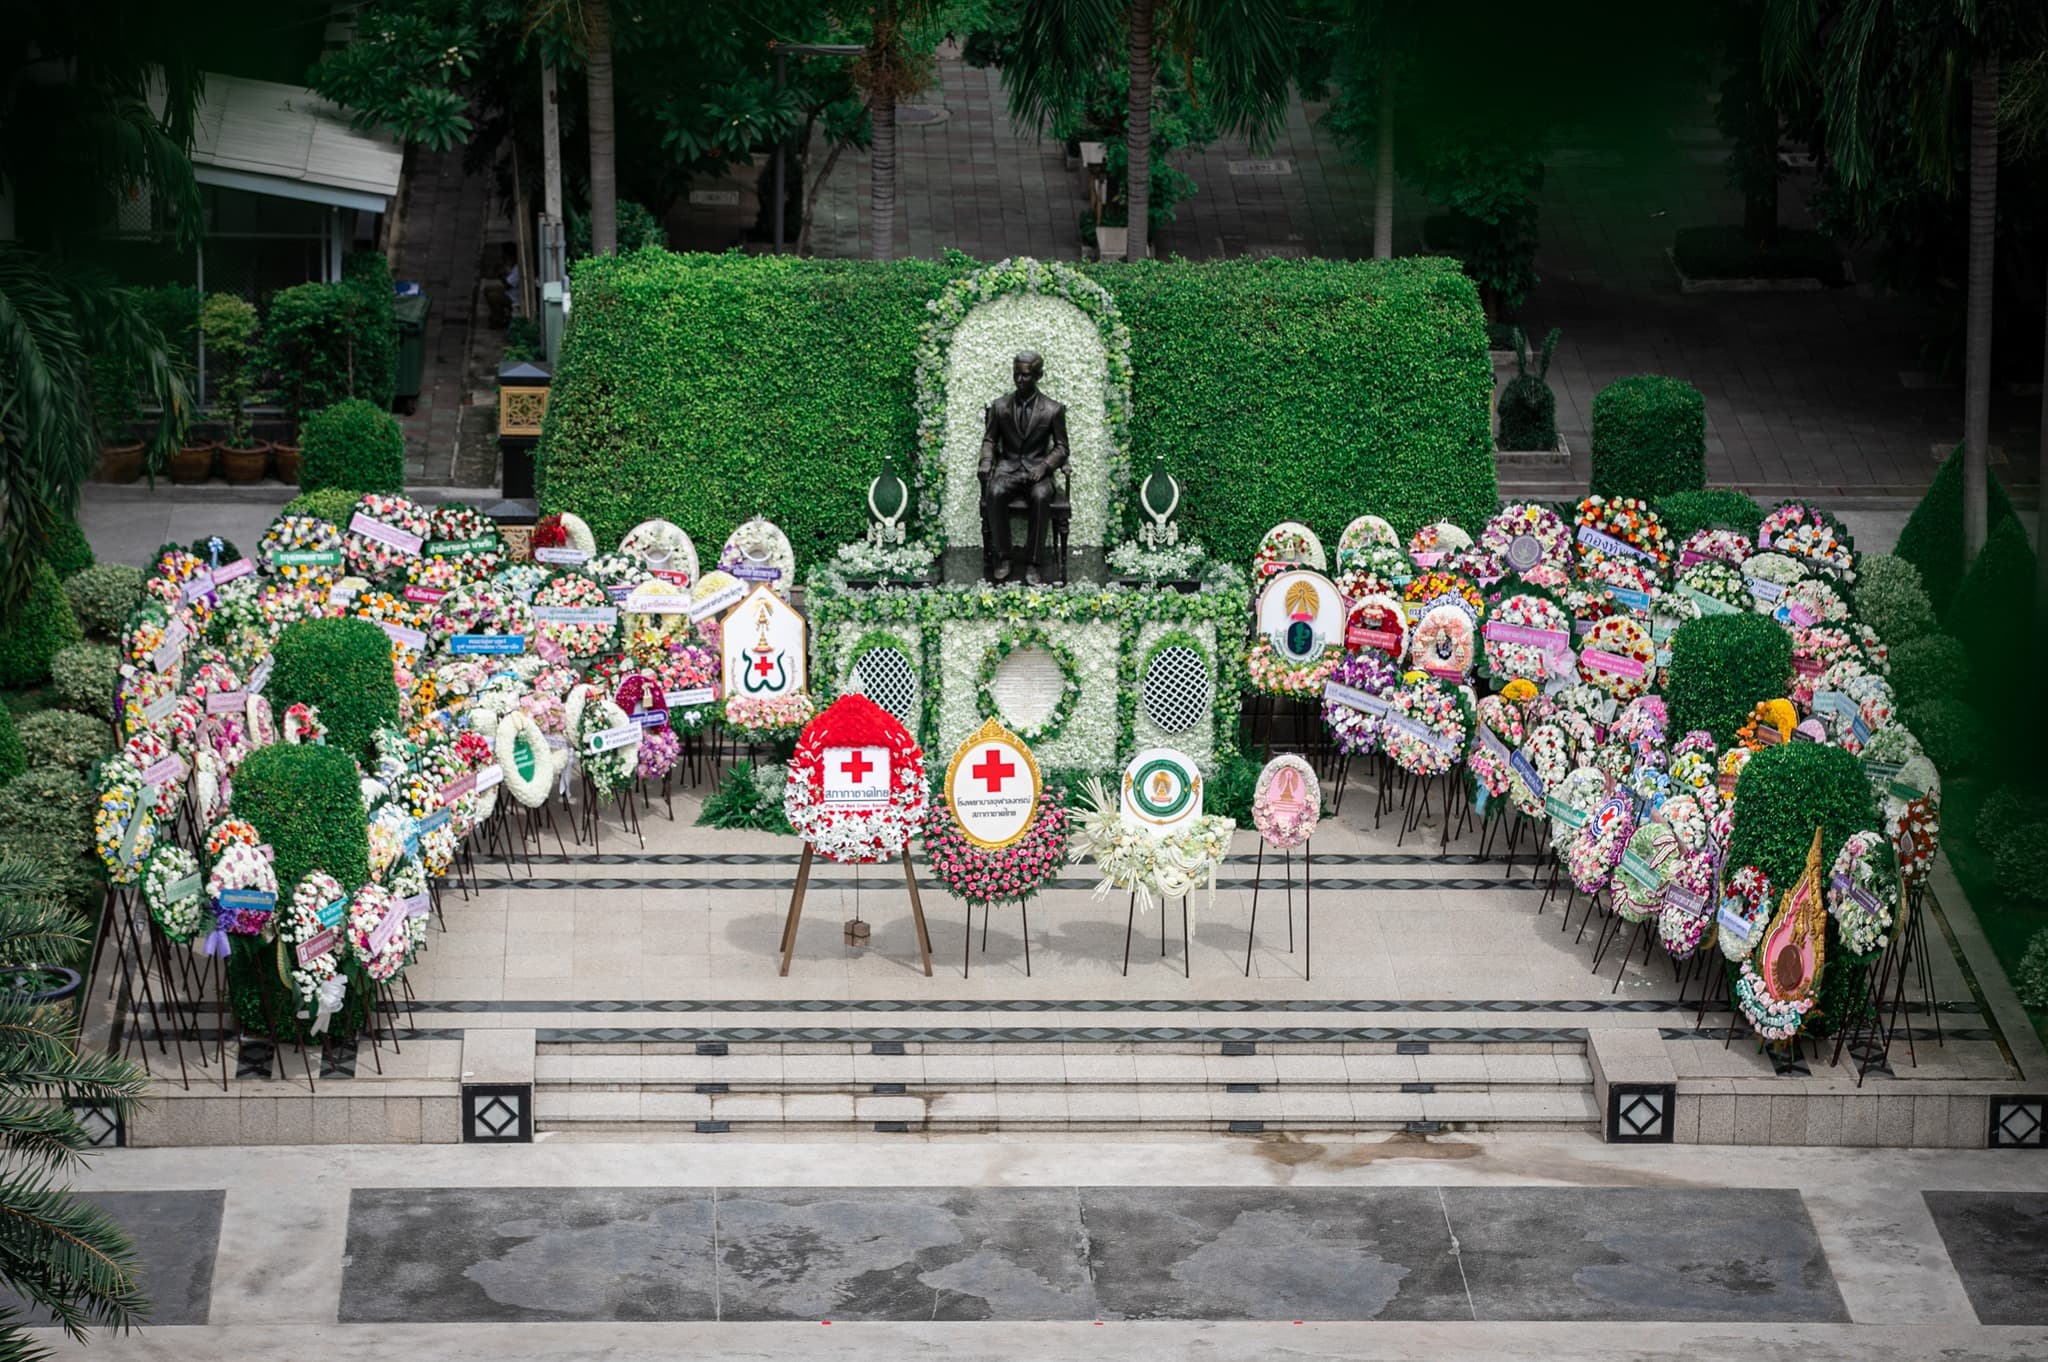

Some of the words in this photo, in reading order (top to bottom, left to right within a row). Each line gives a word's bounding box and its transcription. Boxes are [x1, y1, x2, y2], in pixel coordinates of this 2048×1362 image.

[825, 785, 889, 798] สภากาชาดไทย
[957, 795, 1032, 807] โรงพยาบาลจุฬาลงกรณ์
[972, 808, 1016, 818] สภากาชาดไทย
